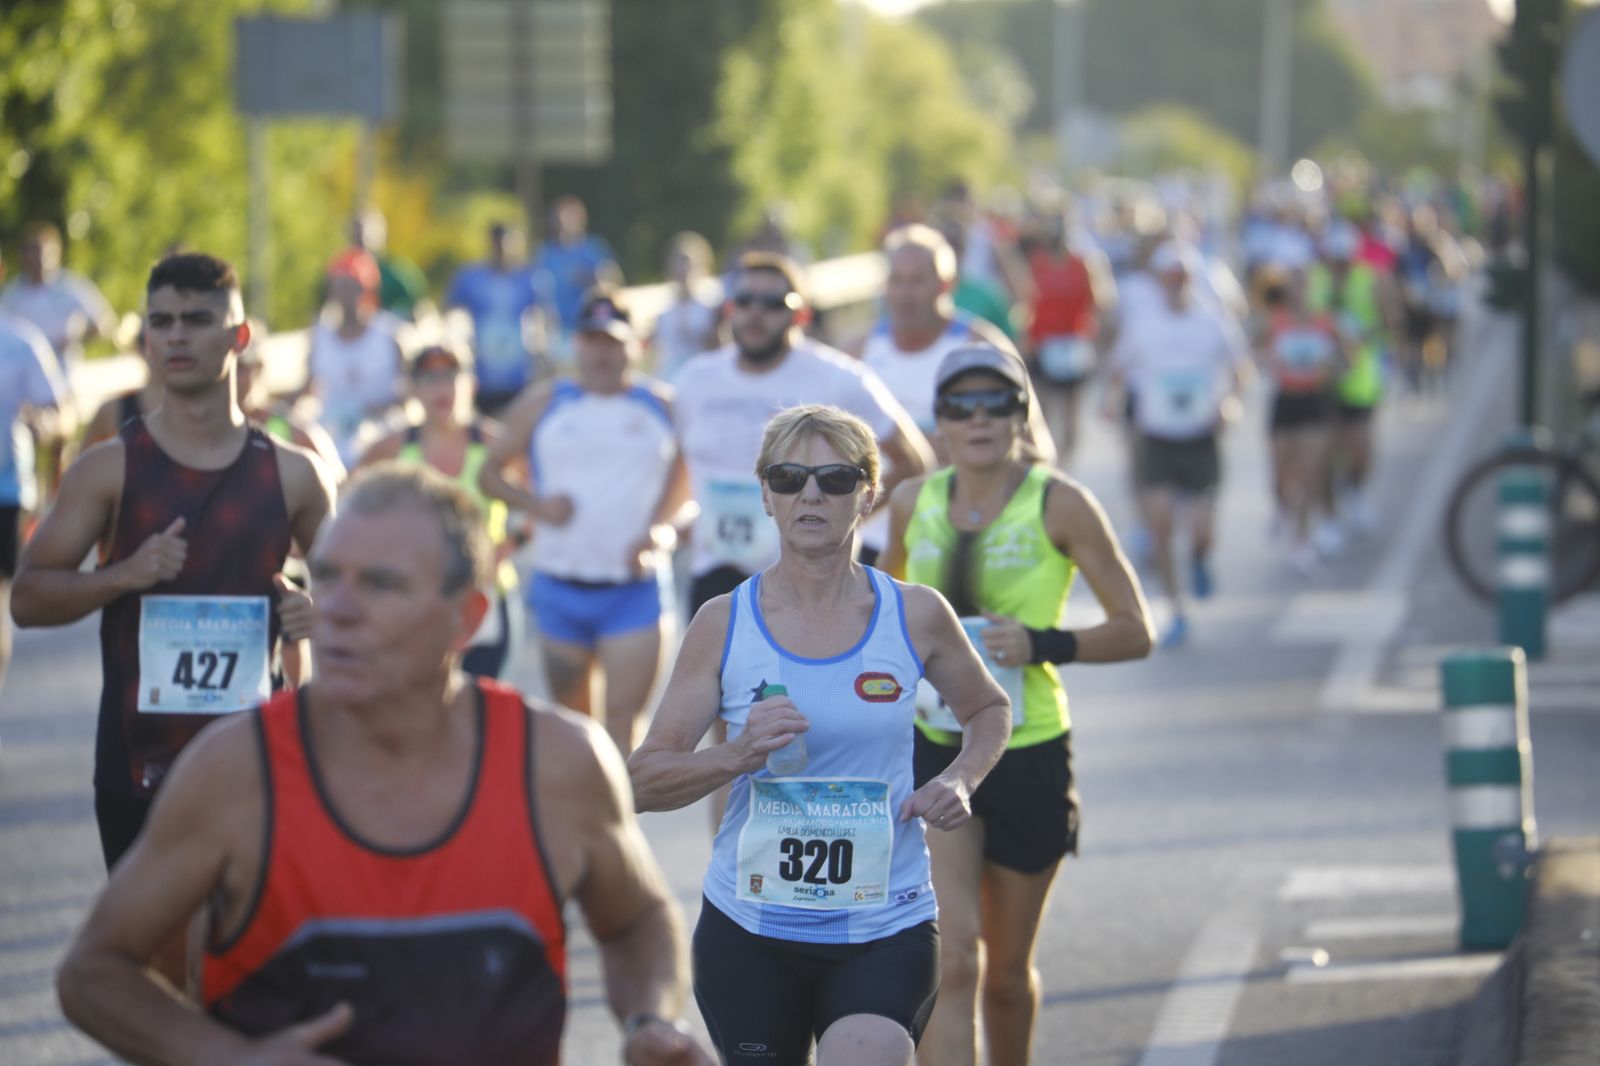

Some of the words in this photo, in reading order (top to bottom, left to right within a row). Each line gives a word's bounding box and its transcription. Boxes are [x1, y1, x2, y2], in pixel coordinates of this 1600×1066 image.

[171, 651, 239, 690] 427
[757, 801, 803, 816] MEDIA
[806, 798, 885, 817] MARATÓN
[779, 837, 854, 885] 320
